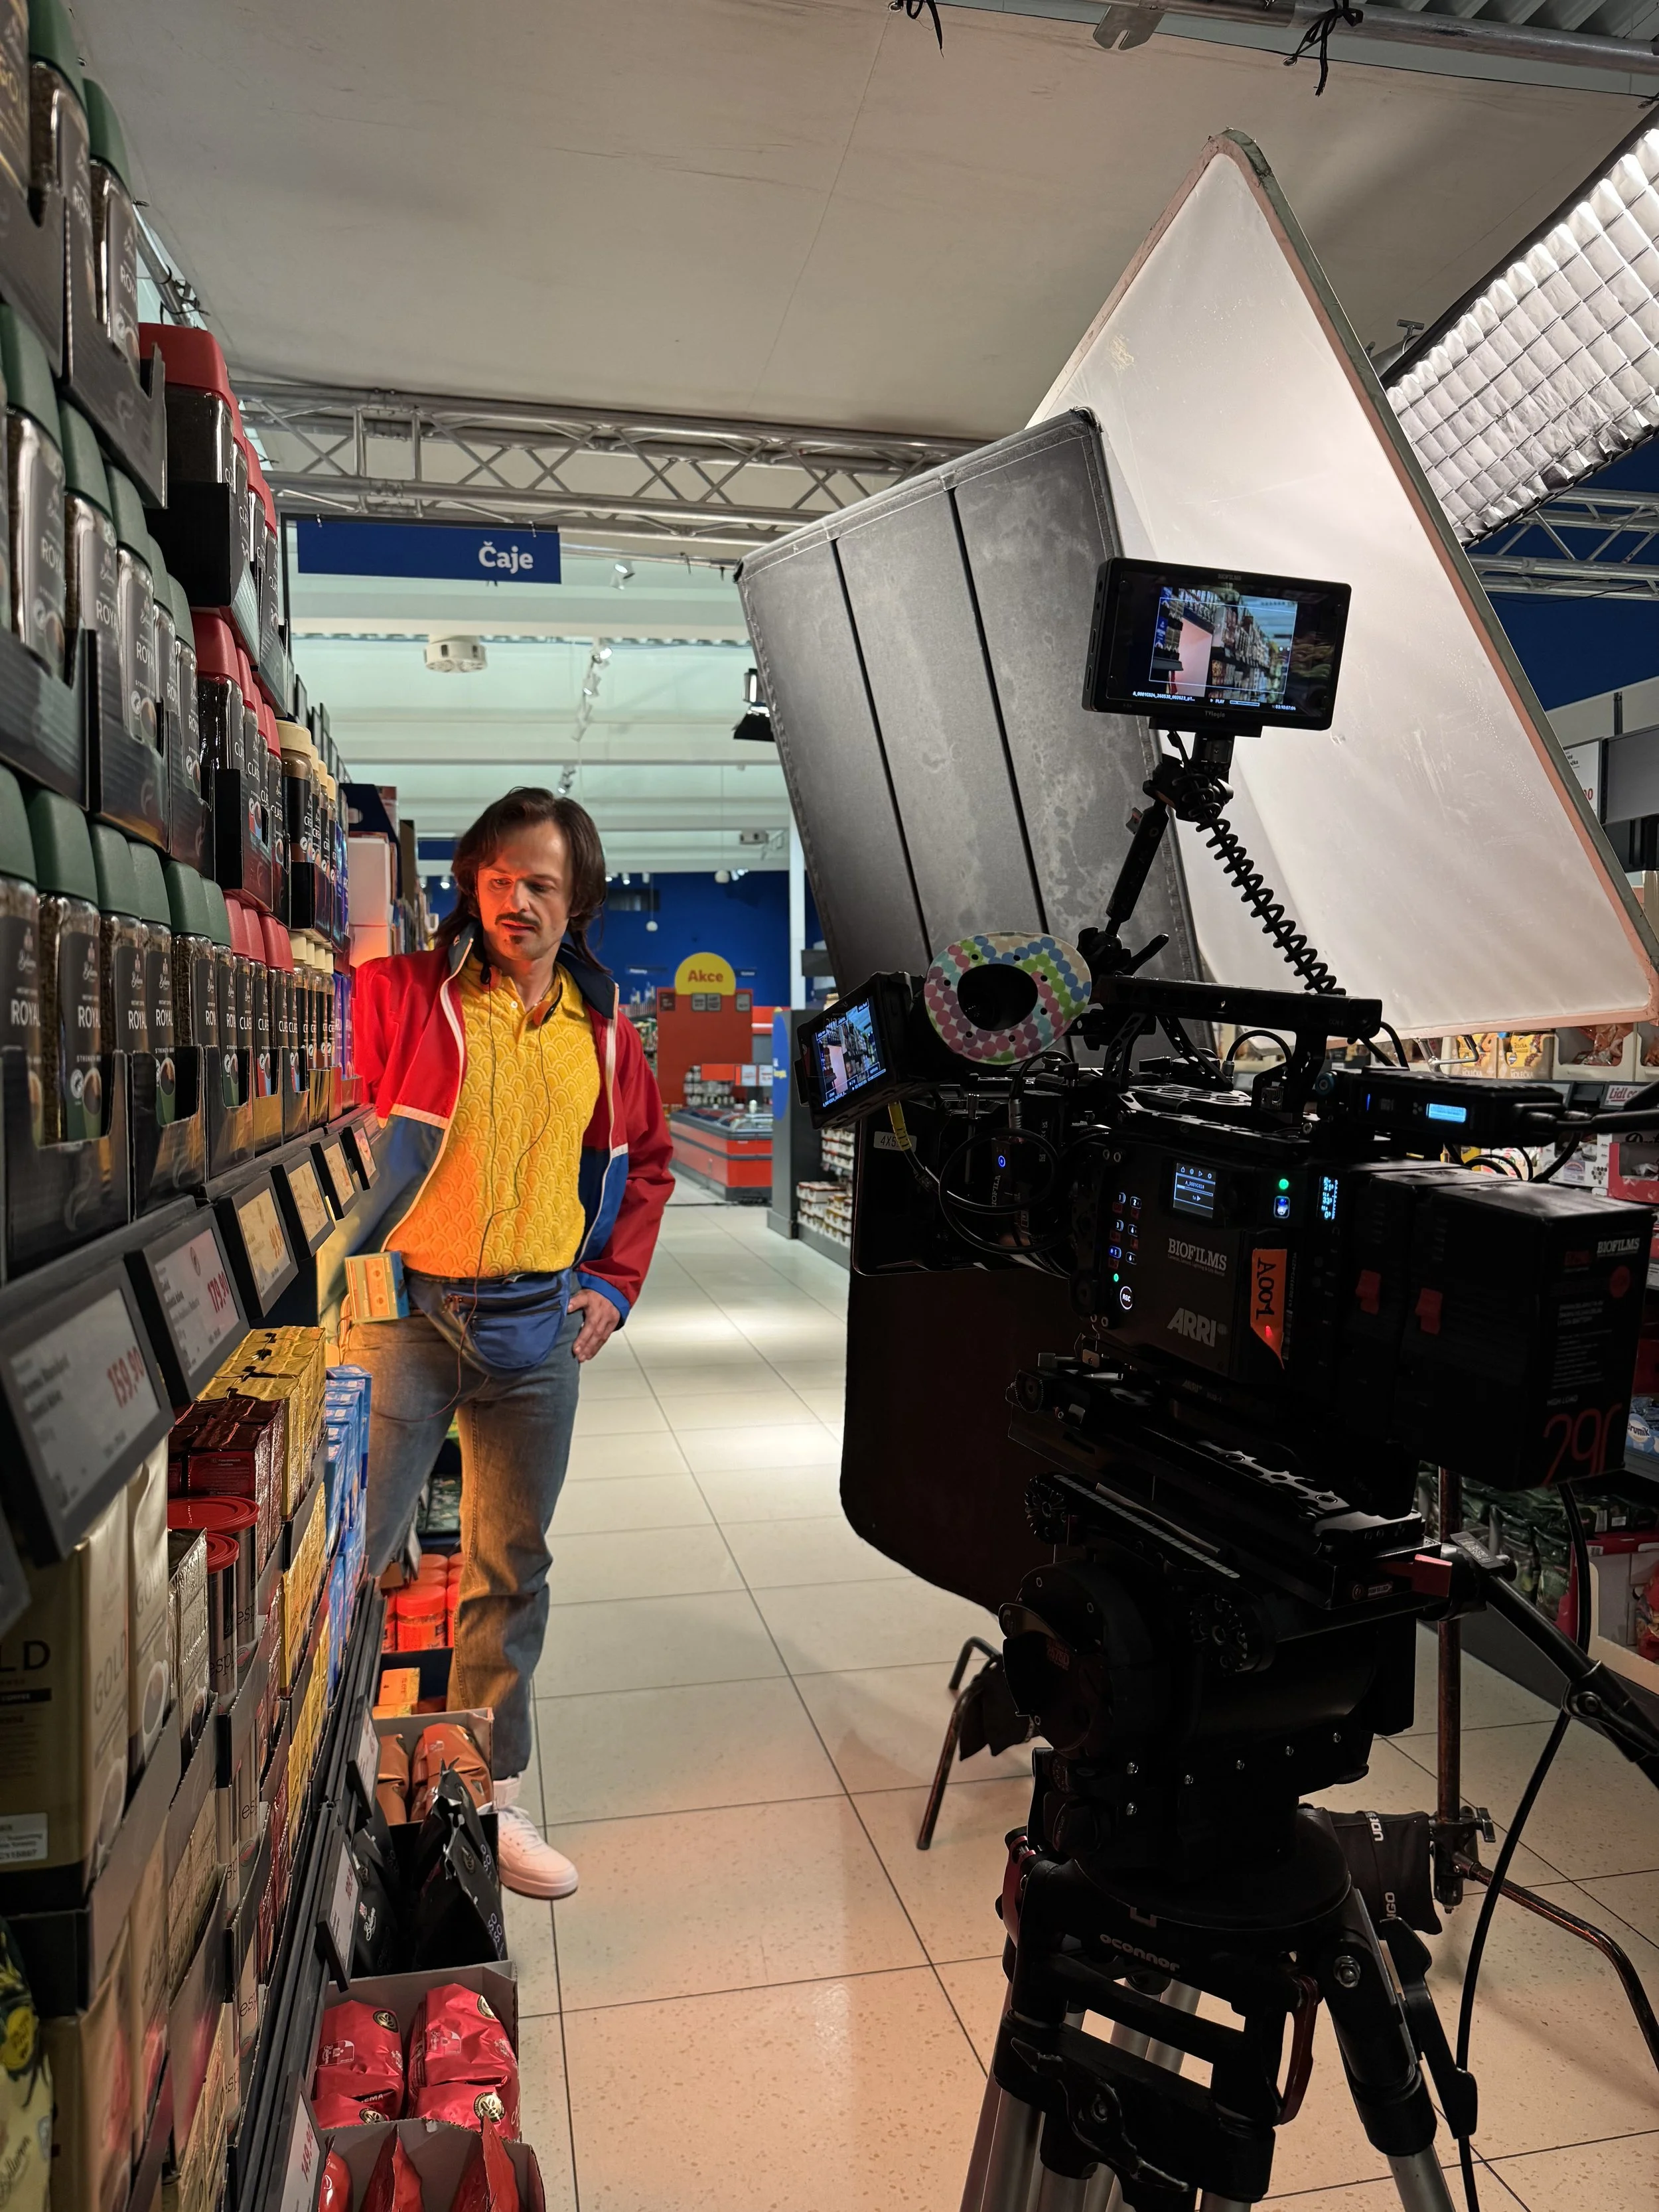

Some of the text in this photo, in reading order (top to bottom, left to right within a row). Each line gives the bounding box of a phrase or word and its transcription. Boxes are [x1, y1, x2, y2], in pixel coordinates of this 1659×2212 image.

[478, 540, 534, 574] Čaje
[688, 970, 724, 982] Akce
[1609, 1087, 1626, 1100] Lidl
[1168, 1237, 1227, 1272] BIOFILMS
[1597, 1237, 1641, 1254] BIOFILMS
[1122, 1293, 1131, 1302] REC
[1255, 1257, 1277, 1321] A001
[1167, 1307, 1217, 1347] ARRI
[1100, 1934, 1180, 1971] oconnor
